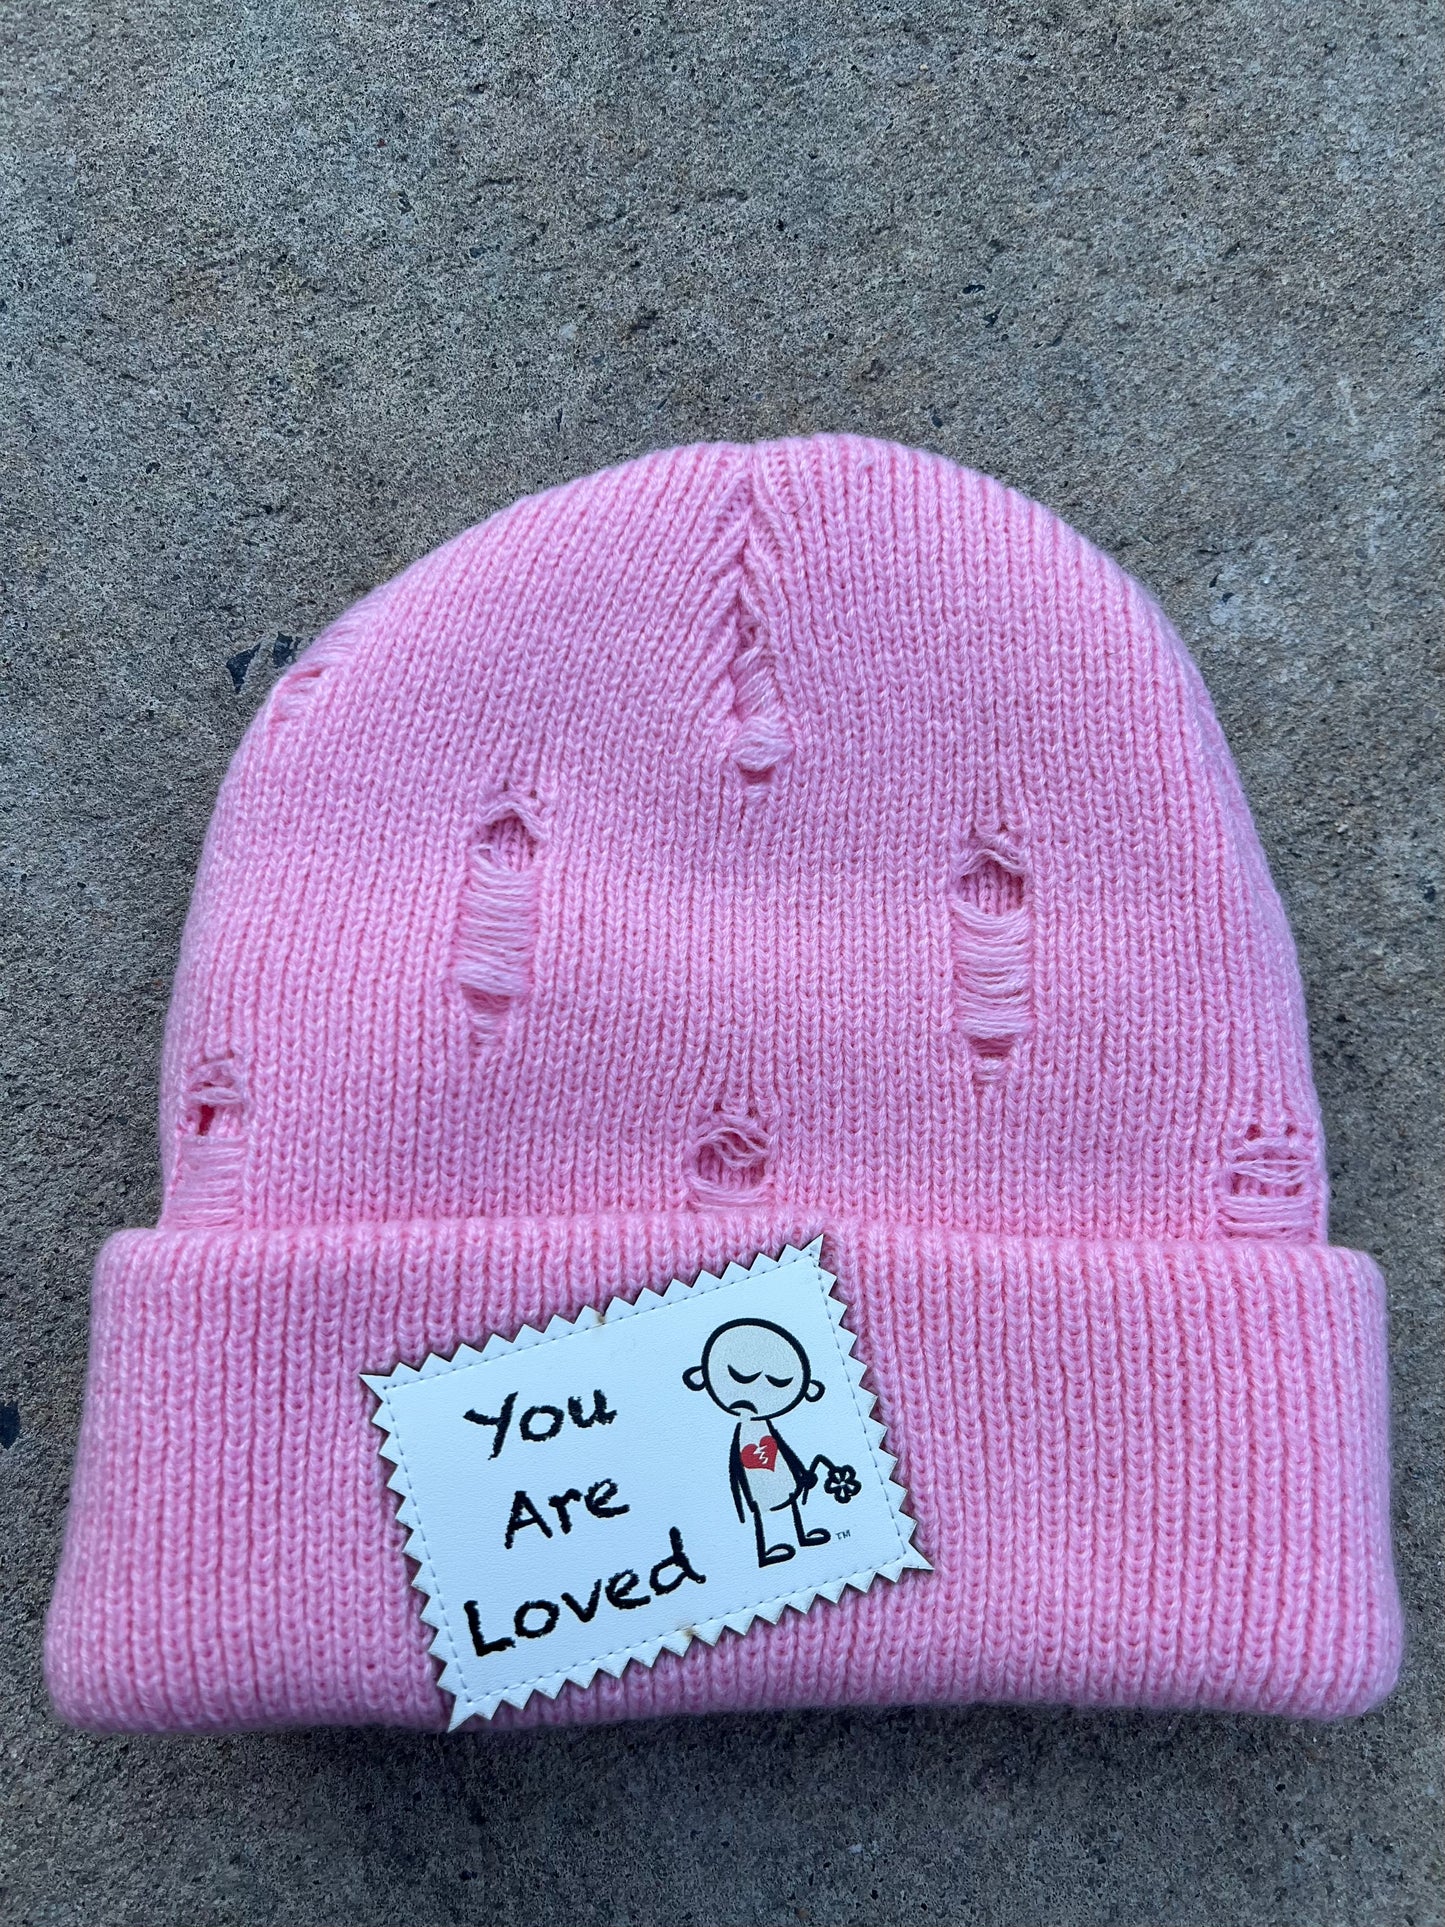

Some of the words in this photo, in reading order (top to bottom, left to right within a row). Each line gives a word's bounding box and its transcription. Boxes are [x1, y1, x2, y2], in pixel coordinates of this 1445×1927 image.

[463, 1389, 617, 1460] You
[504, 1478, 630, 1548] Are
[835, 1529, 851, 1540] TM
[464, 1527, 706, 1656] Loved
